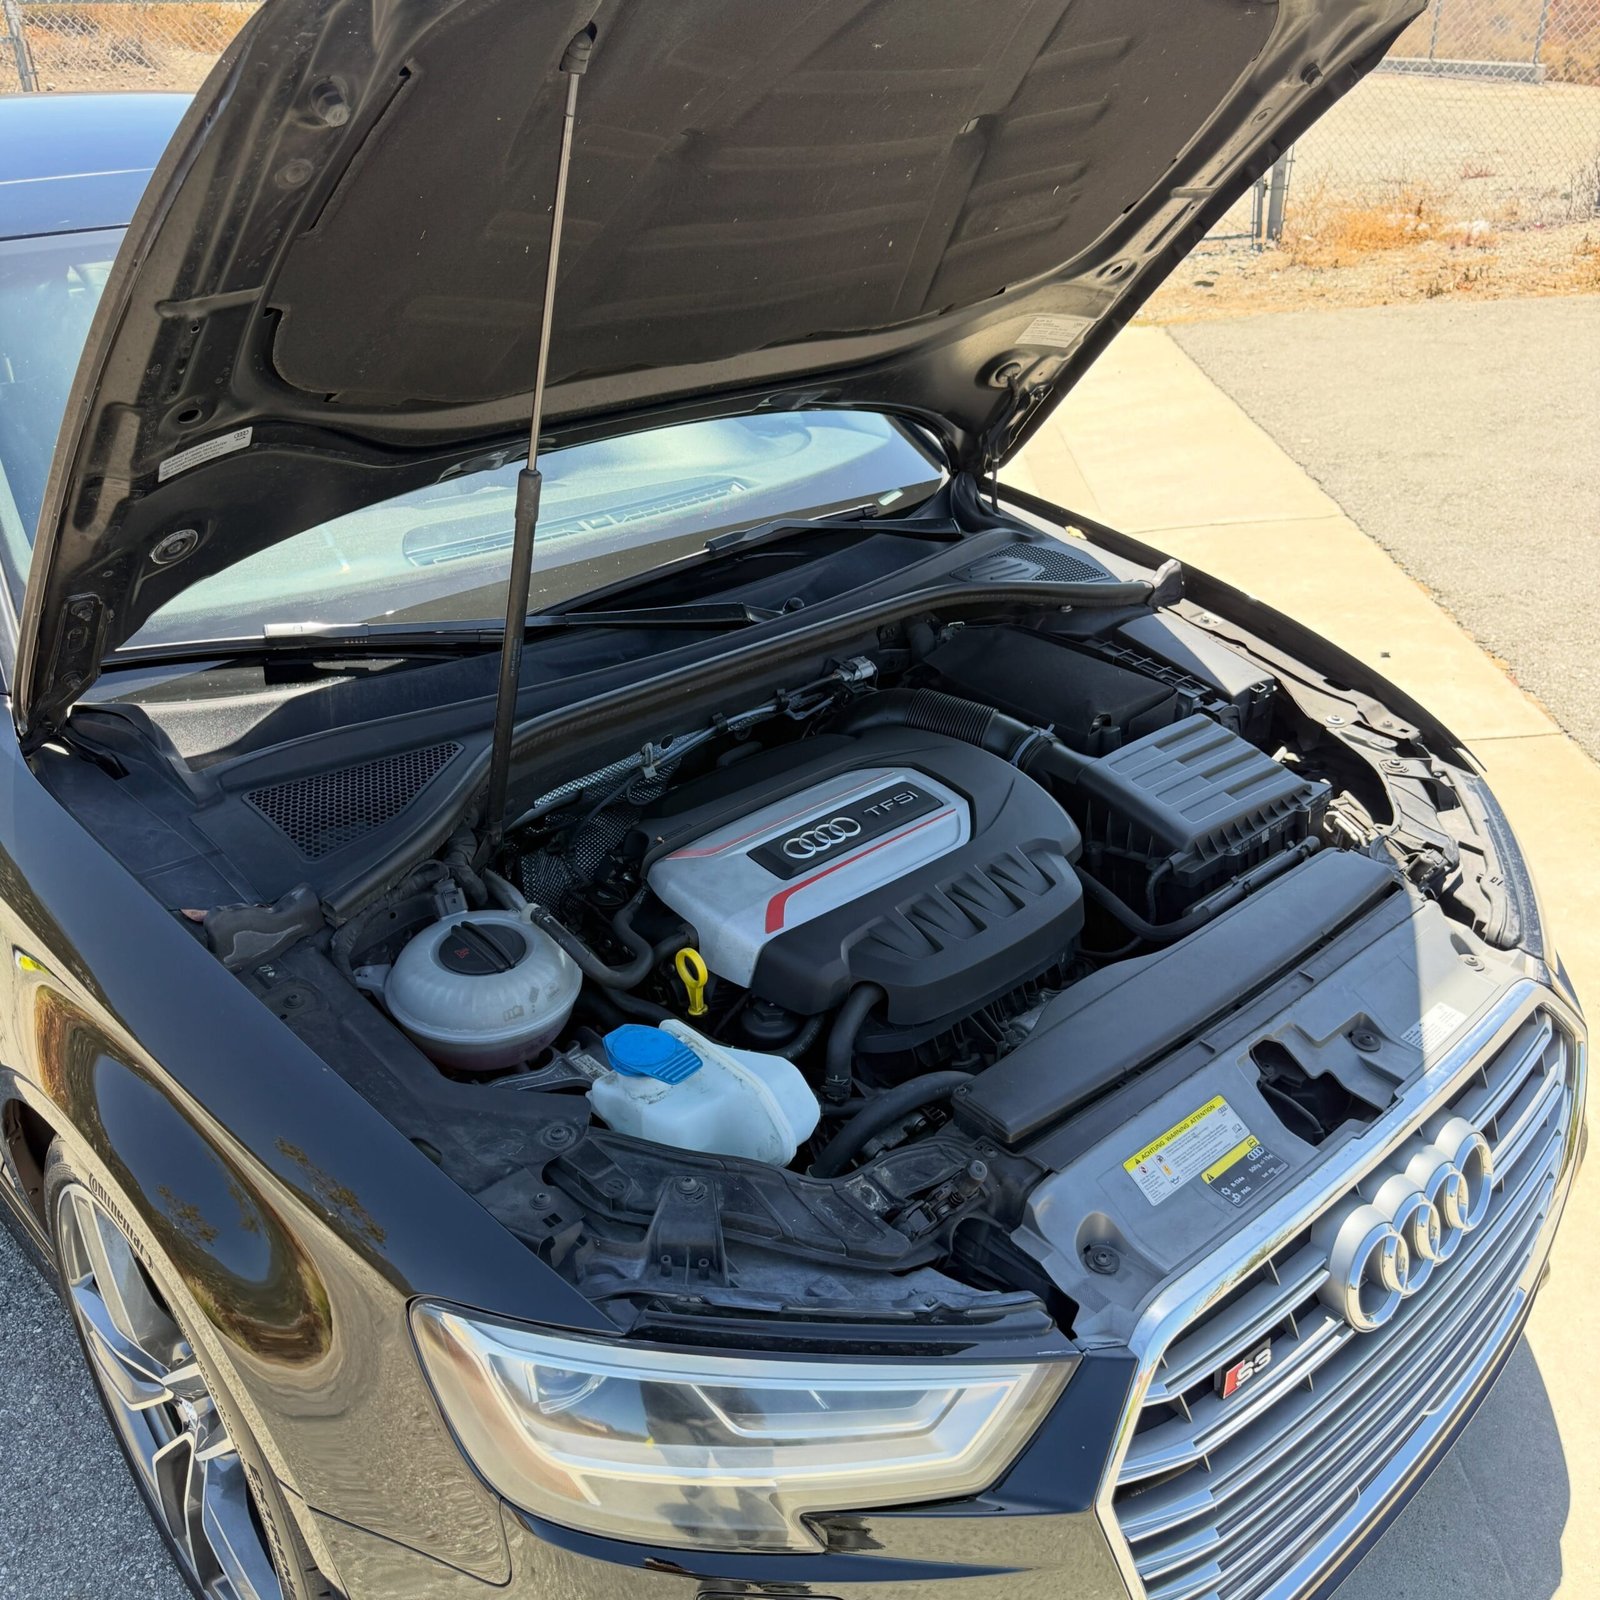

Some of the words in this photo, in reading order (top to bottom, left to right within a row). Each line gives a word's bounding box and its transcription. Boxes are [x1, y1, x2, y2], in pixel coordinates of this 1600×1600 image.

[863, 790, 919, 817] TFSI
[1141, 1141, 1166, 1160] ACHTUNG
[1165, 1123, 1190, 1142] WARNING
[1189, 1104, 1216, 1125] ATTENTION
[88, 1172, 145, 1256] Continental
[1236, 1348, 1272, 1387] S3
